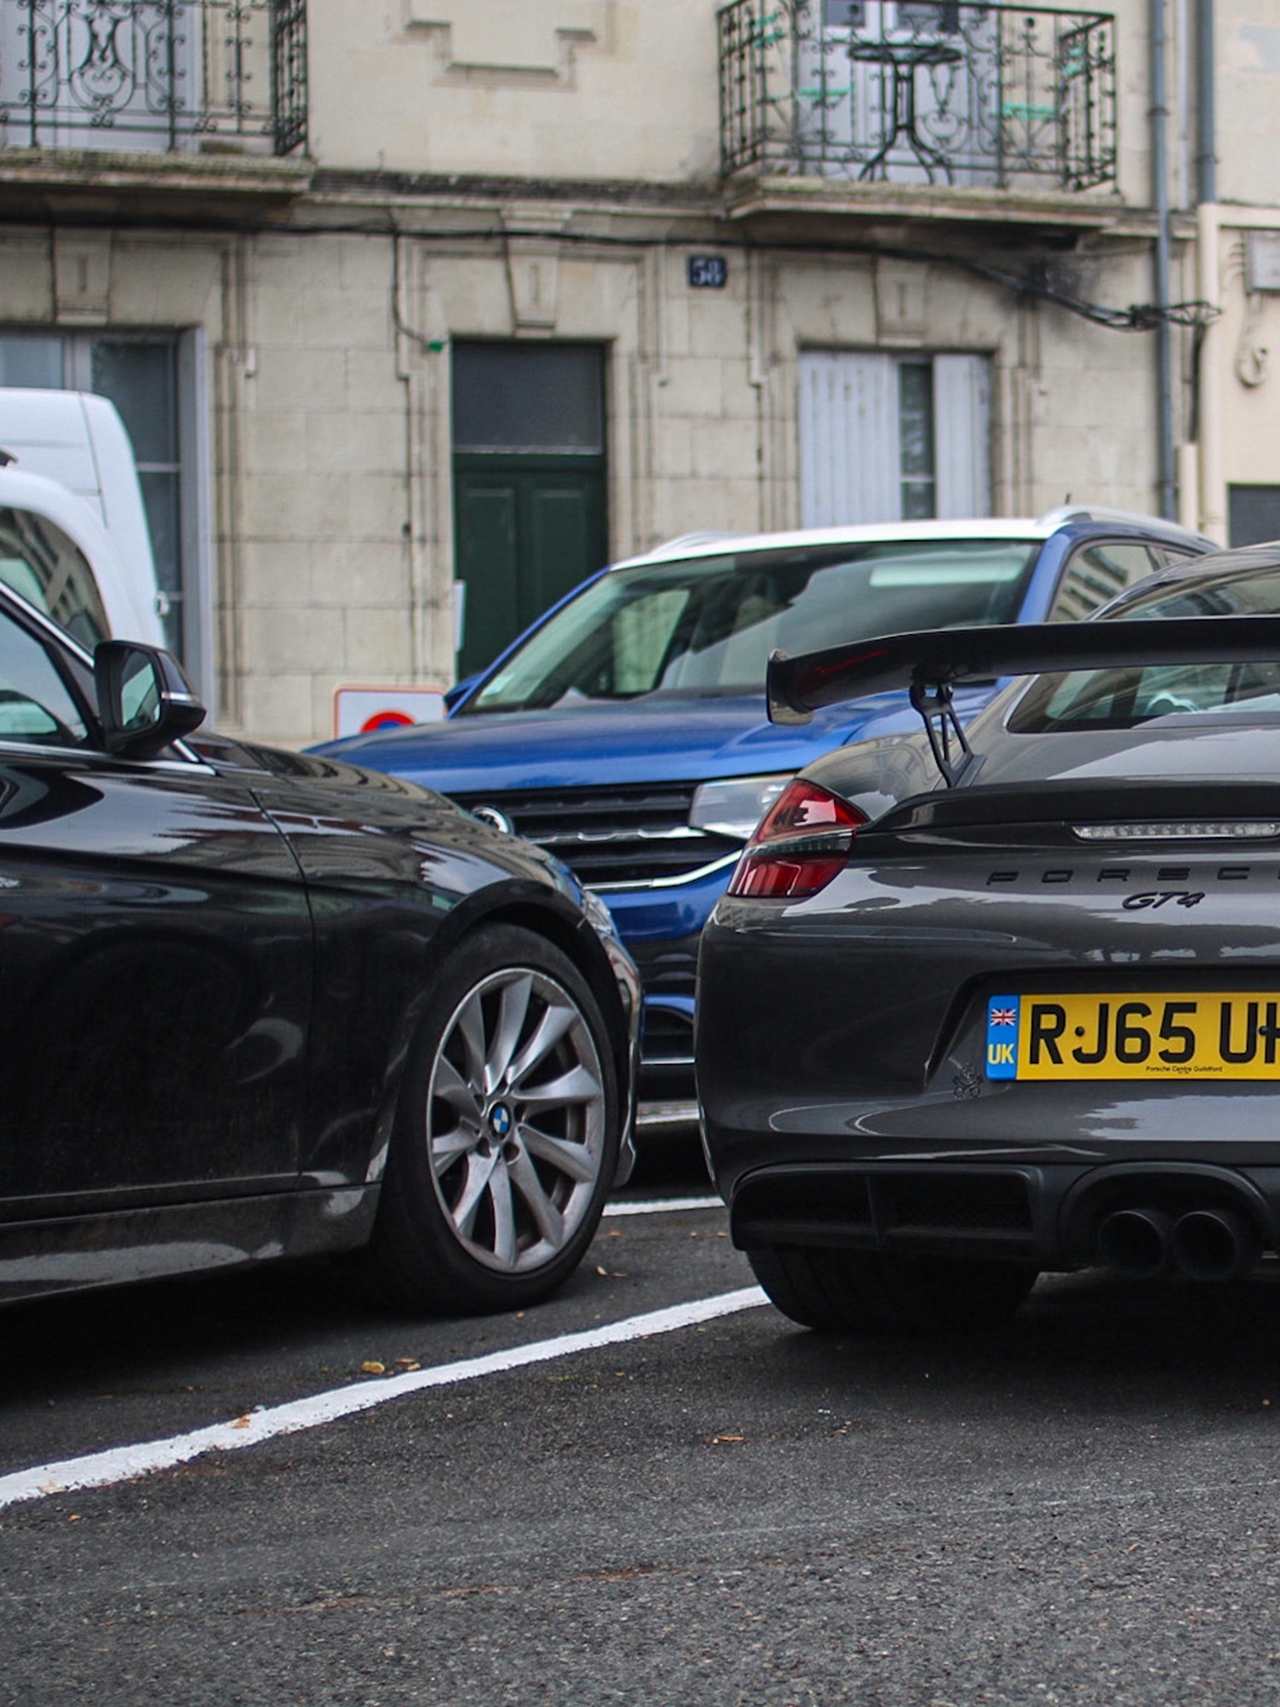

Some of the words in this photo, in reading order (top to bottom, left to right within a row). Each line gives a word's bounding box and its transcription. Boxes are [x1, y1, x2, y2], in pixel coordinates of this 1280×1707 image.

[693, 258, 723, 285] 58
[1121, 891, 1206, 911] GT4
[1029, 1001, 1197, 1065] RJ65
[988, 1043, 1015, 1065] UK
